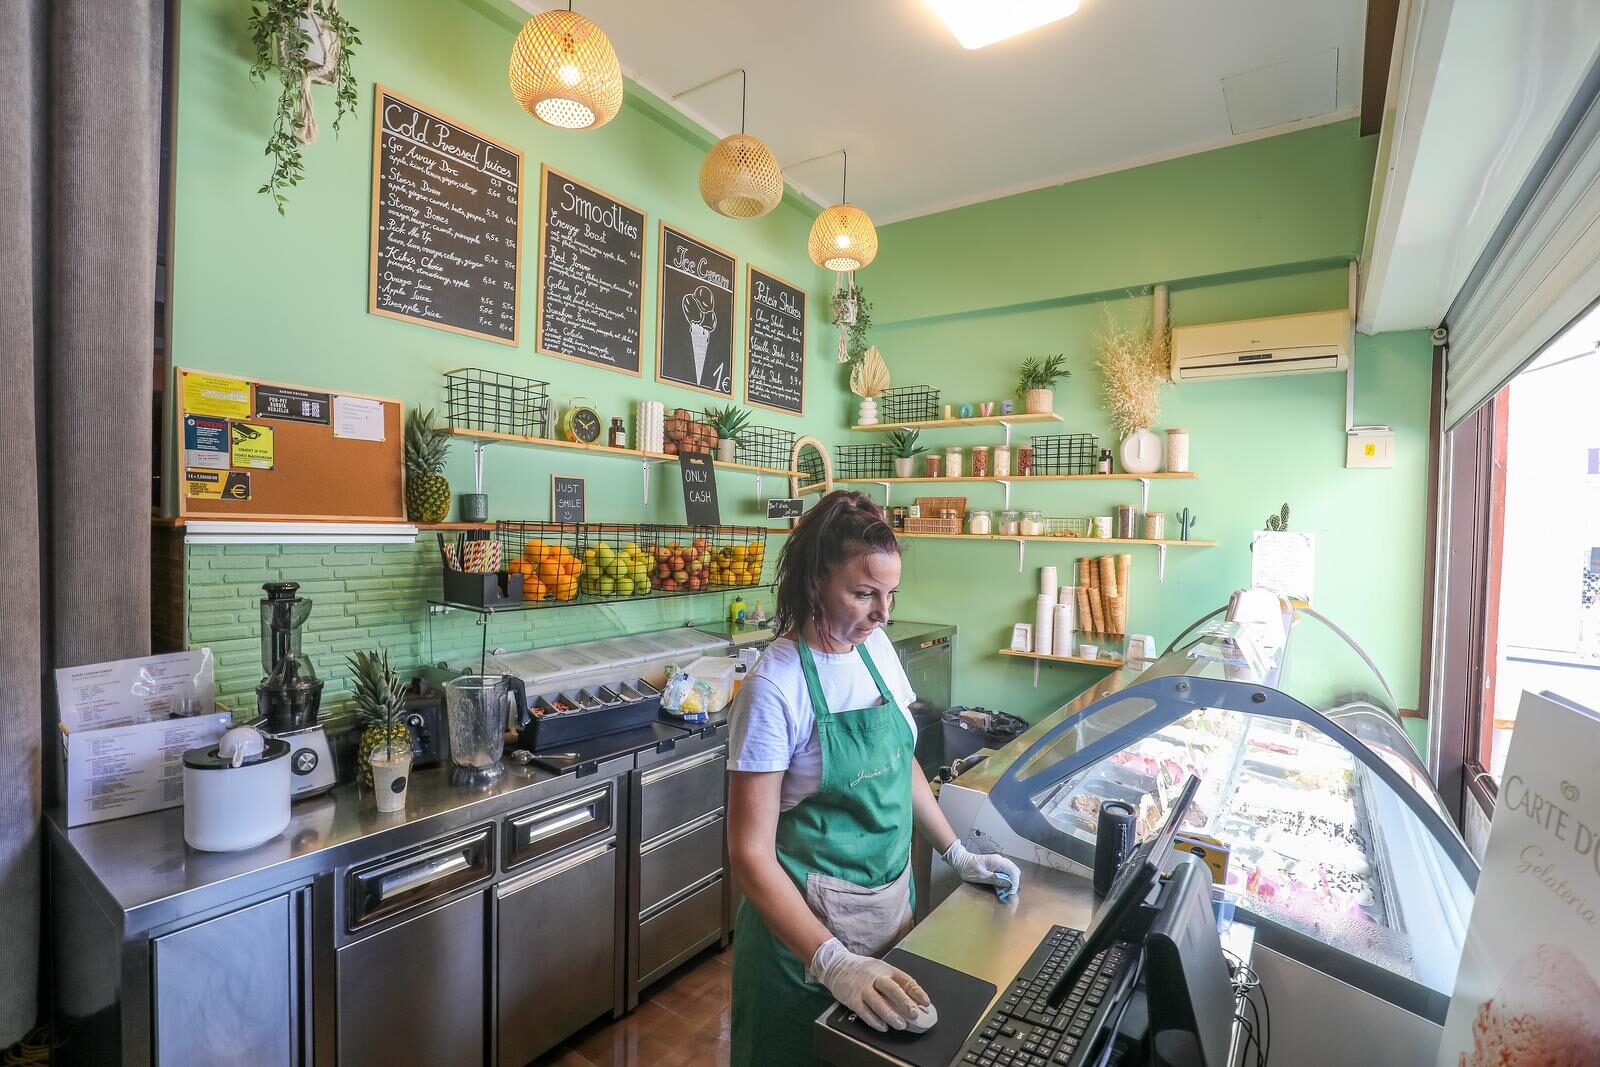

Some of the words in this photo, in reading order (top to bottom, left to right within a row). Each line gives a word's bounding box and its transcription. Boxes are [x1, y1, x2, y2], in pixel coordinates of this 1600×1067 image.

[385, 104, 429, 144] Cold
[432, 124, 479, 164] Pressed
[476, 146, 511, 178] Juices
[388, 136, 403, 153] Go
[405, 146, 437, 169] Away
[439, 160, 459, 176] Doc
[388, 167, 416, 187] Stress
[420, 180, 441, 196] Down
[387, 193, 420, 217] Strong
[424, 206, 448, 224] Bones
[561, 183, 637, 240] Smoothies
[386, 218, 406, 235] Pick
[407, 226, 420, 238] Me
[421, 230, 432, 245] Up
[551, 208, 580, 237] Energy
[421, 256, 443, 272] Choice
[549, 245, 566, 264] Red
[571, 253, 591, 271] Power
[673, 245, 696, 273] Ice
[697, 257, 729, 288] Cream
[382, 282, 406, 296] Apple
[410, 290, 432, 303] Juice
[384, 271, 412, 287] Orange
[414, 279, 433, 291] Juice
[547, 276, 569, 291] Golden
[382, 294, 421, 314] Pineapple
[421, 305, 443, 318] Juice
[754, 281, 777, 308] Protein
[779, 291, 801, 318] Shakes
[563, 327, 585, 340] Colada
[713, 362, 731, 393] 1€
[556, 482, 579, 493] JUST
[685, 469, 707, 482] ONLY
[558, 499, 581, 508] SMILE
[689, 490, 712, 503] CASH
[1504, 775, 1569, 841] CARTE
[1516, 845, 1597, 925] Gelateria
